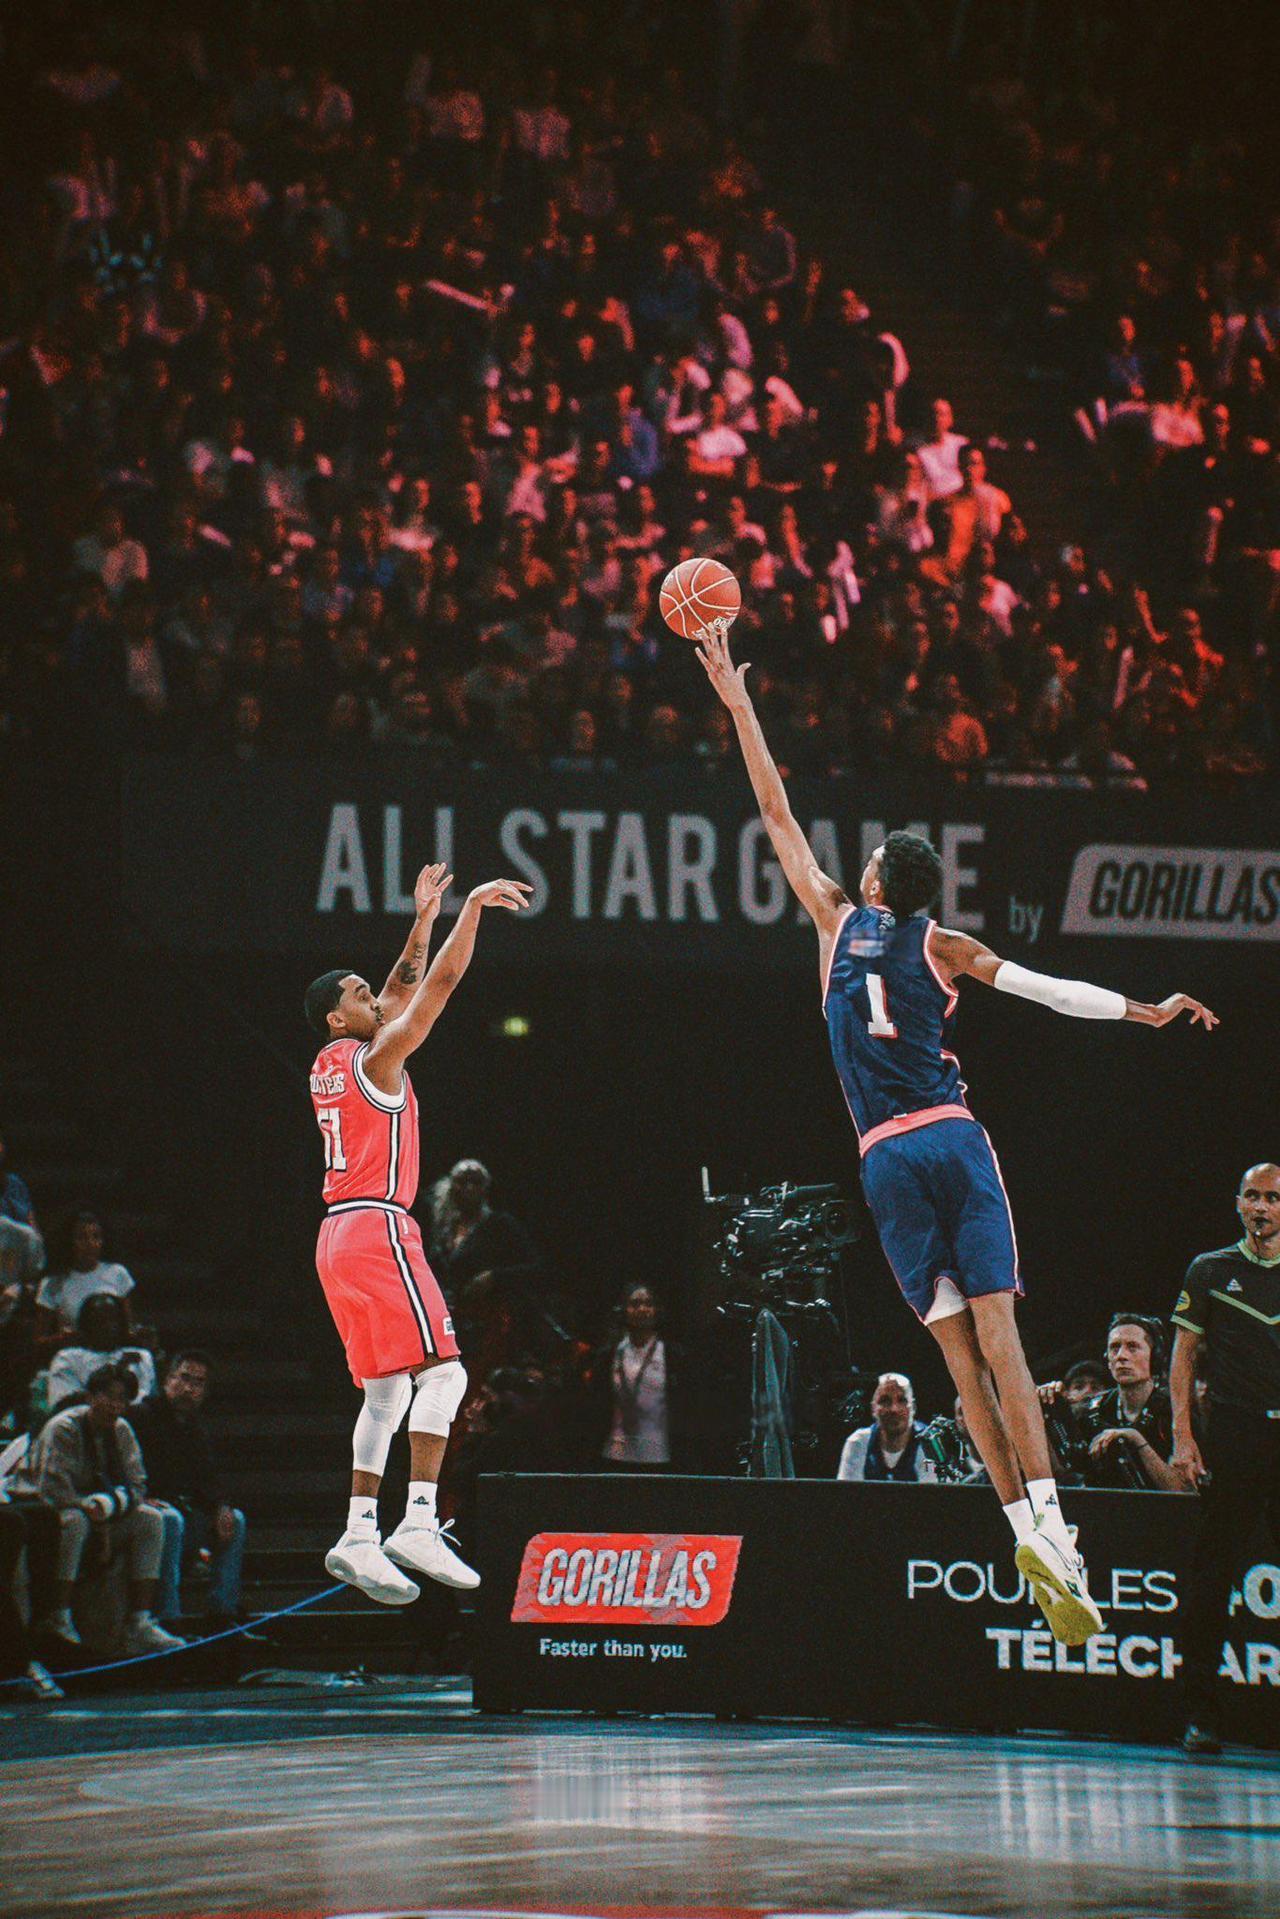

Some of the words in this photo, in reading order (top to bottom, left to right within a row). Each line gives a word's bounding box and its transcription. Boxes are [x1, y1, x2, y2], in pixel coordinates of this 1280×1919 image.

[316, 803, 464, 912] ALL
[501, 808, 720, 922] STAR
[1009, 896, 1044, 943] by
[1088, 861, 1280, 925] GORILLAS
[866, 973, 898, 1038] 1
[537, 1548, 717, 1609] GORILLAS
[540, 1639, 597, 1656] Faster
[604, 1640, 644, 1657] than
[650, 1643, 687, 1662] you.
